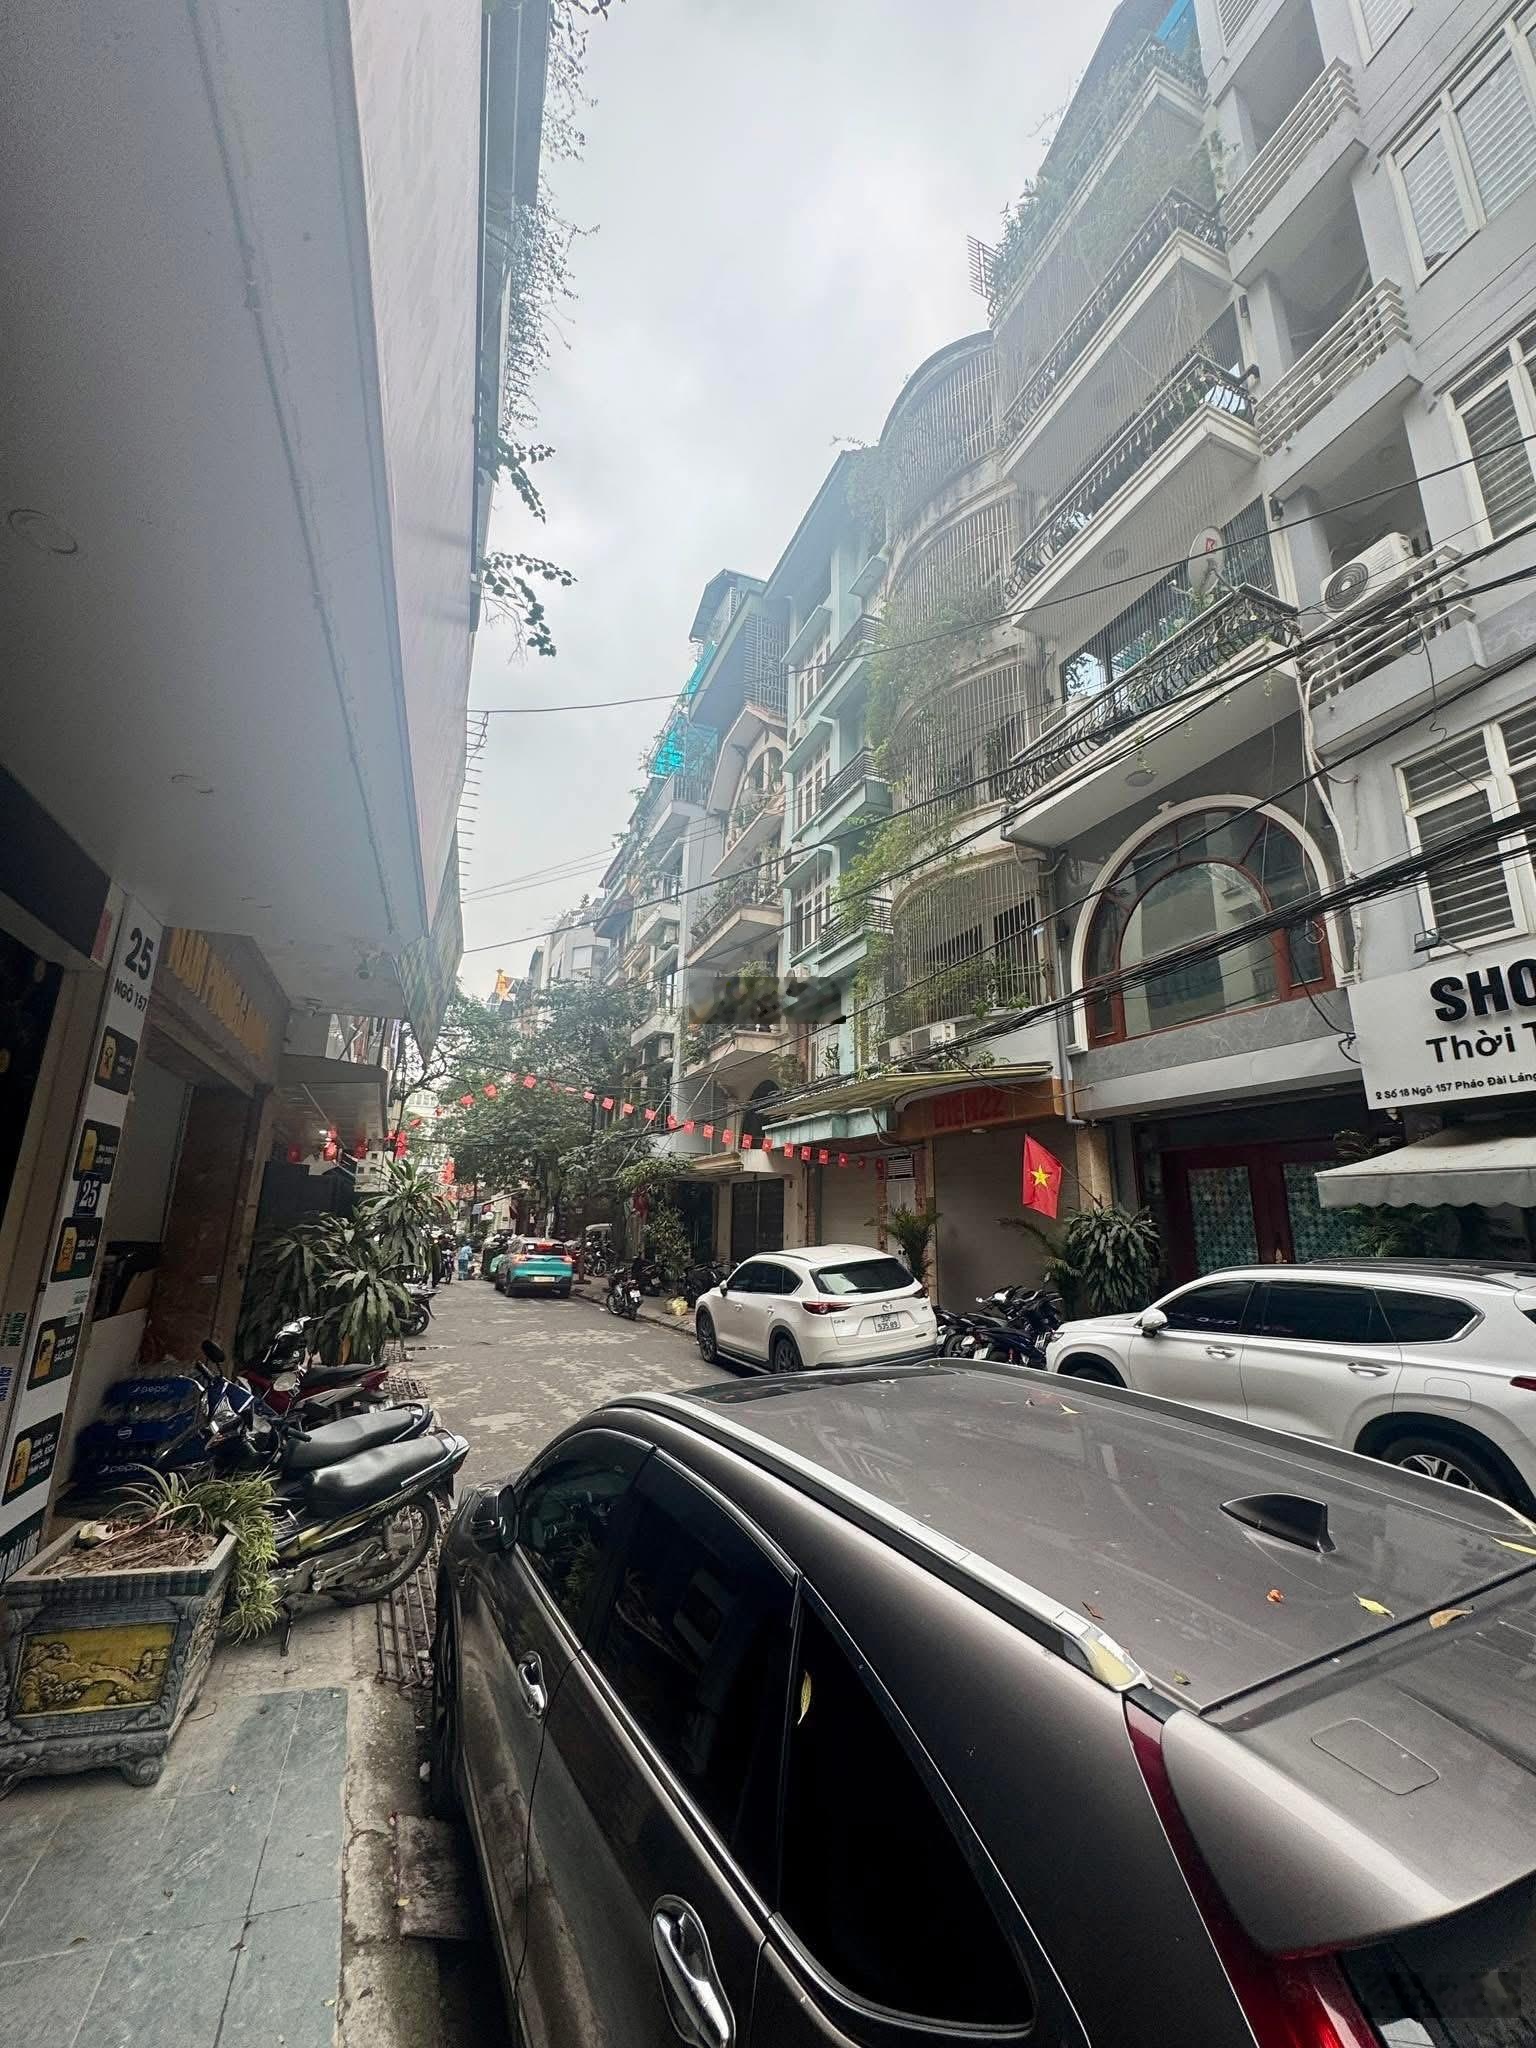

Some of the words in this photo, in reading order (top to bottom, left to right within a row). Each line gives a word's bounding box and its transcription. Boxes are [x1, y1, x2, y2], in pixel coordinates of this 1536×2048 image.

[125, 927, 155, 980] 25
[134, 992, 147, 1012] 157
[1425, 1025, 1516, 1063] Thời
[1384, 1088, 1397, 1099] Số
[1412, 1085, 1433, 1097] Ngõ
[1435, 1082, 1452, 1093] 157
[79, 1180, 100, 1208] 25
